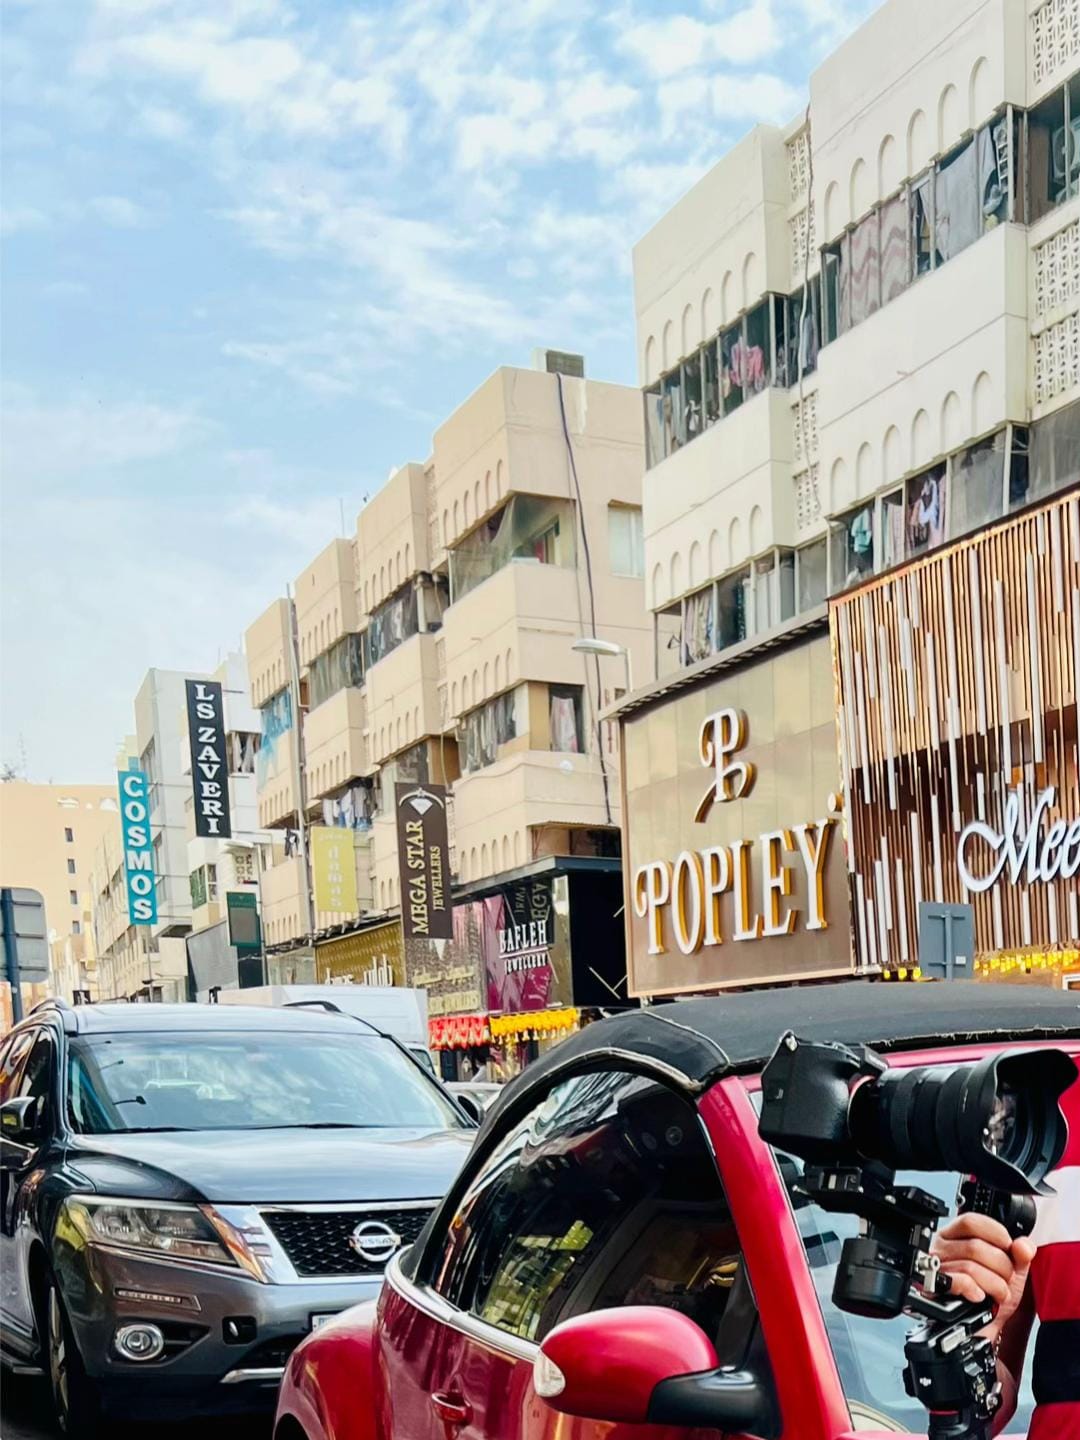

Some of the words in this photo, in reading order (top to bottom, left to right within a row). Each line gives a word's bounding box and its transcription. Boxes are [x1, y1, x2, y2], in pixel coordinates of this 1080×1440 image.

[195, 684, 216, 720] LS
[198, 727, 224, 834] ZAVERI
[123, 776, 153, 921] COSMOS
[406, 820, 426, 869] STAR
[409, 874, 429, 935] MEGA
[430, 846, 446, 911] JEWELLERS
[634, 816, 840, 955] POPLEY
[499, 920, 548, 953] BAFLEH
